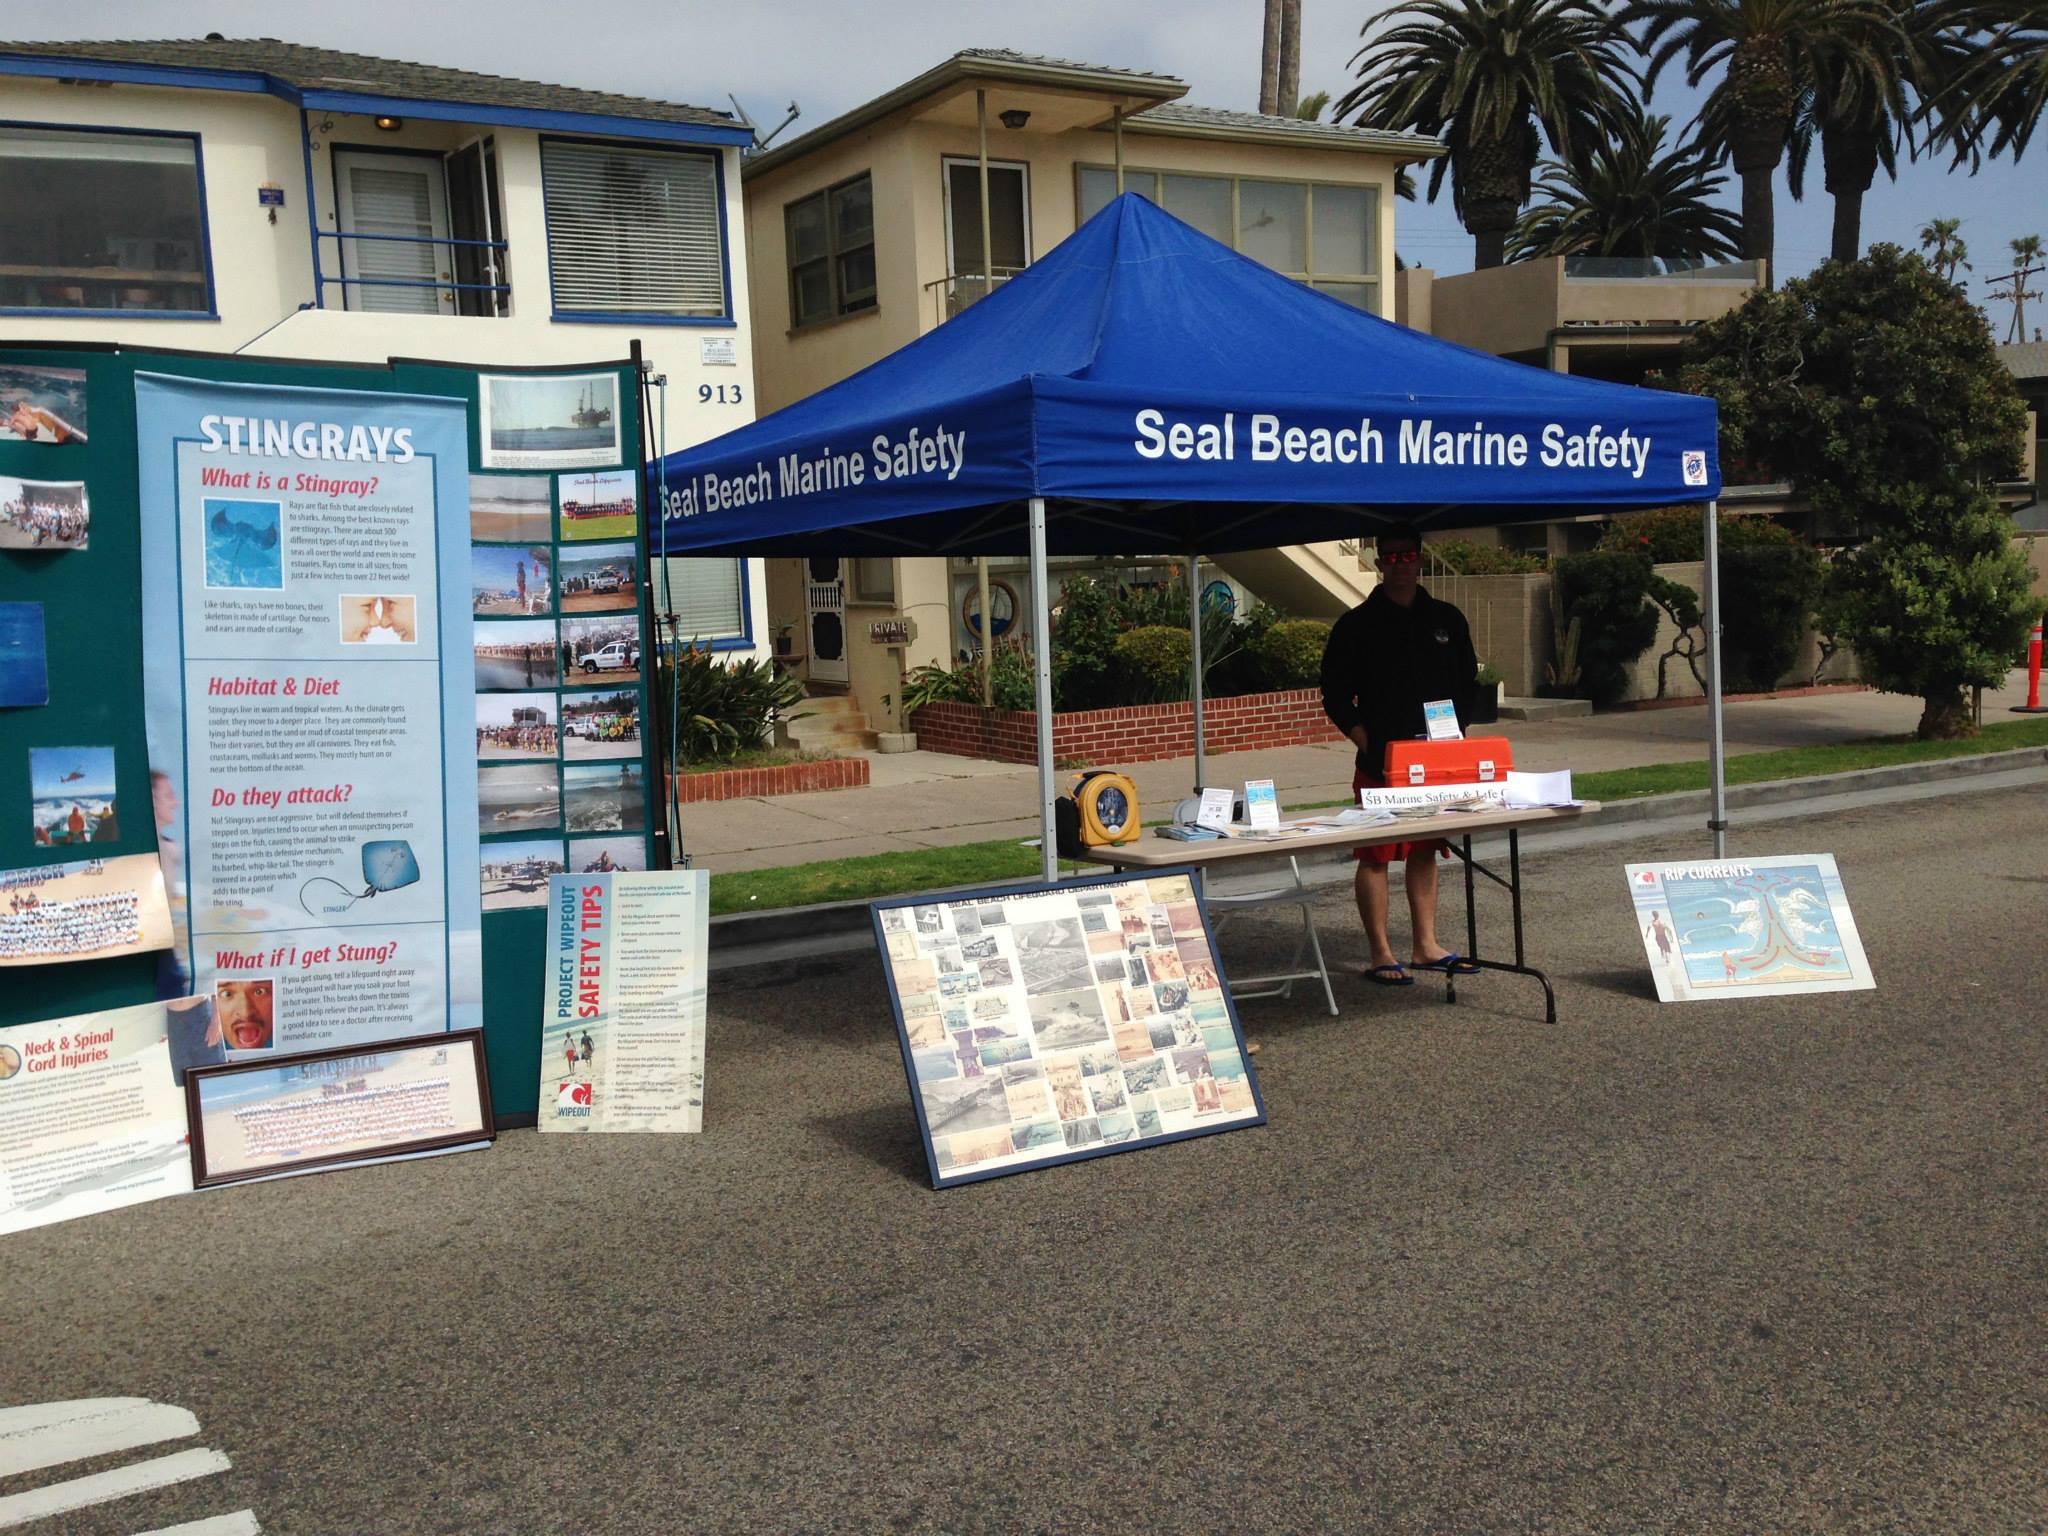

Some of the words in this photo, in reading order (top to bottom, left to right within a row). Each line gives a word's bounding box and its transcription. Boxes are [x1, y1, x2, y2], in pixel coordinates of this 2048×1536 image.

[698, 384, 742, 404] 913
[200, 415, 414, 464] STINGRAYS
[1135, 408, 1234, 460] Seal
[1250, 414, 1384, 463] Beach
[1399, 420, 1528, 466] Marine
[1539, 423, 1650, 479] Safety
[201, 467, 250, 489] What
[256, 471, 270, 490] is
[278, 476, 288, 491] a
[295, 473, 379, 498] Stingray?
[661, 478, 699, 521] Seal
[704, 462, 772, 512] Beach
[779, 447, 864, 498] Marine
[872, 424, 965, 481] Safety
[869, 622, 907, 635] PRIVATE
[208, 677, 278, 696] Habitat
[283, 678, 296, 696] &
[303, 677, 340, 696] Diet
[211, 788, 236, 807] Do
[243, 787, 281, 809] they
[287, 784, 352, 804] attack?
[1366, 795, 1382, 805] SB
[1385, 794, 1422, 804] Marine
[1426, 790, 1459, 802] Safety
[1463, 790, 1471, 799] &
[1664, 867, 1685, 880] RIP
[1688, 864, 1753, 879] CURRENTS
[977, 896, 1011, 904] BEACH
[1013, 890, 1065, 900] LIFEGUARD
[1068, 882, 1129, 893] DEPARTMENT
[560, 886, 576, 951] WIPEOUT
[581, 885, 603, 932] TIPS
[215, 950, 264, 969] What
[270, 948, 286, 966] if
[288, 947, 296, 966] I
[302, 946, 330, 969] get
[336, 941, 398, 965] Stung?
[558, 957, 574, 1018] PROJECT
[578, 938, 601, 1018] SAFETY
[25, 1038, 55, 1056] Neck
[59, 1036, 69, 1049] &
[74, 1028, 114, 1051] Spinal
[27, 1053, 56, 1073] Cord
[61, 1048, 109, 1070] Injuries
[558, 1107, 591, 1117] WIPEOUT
